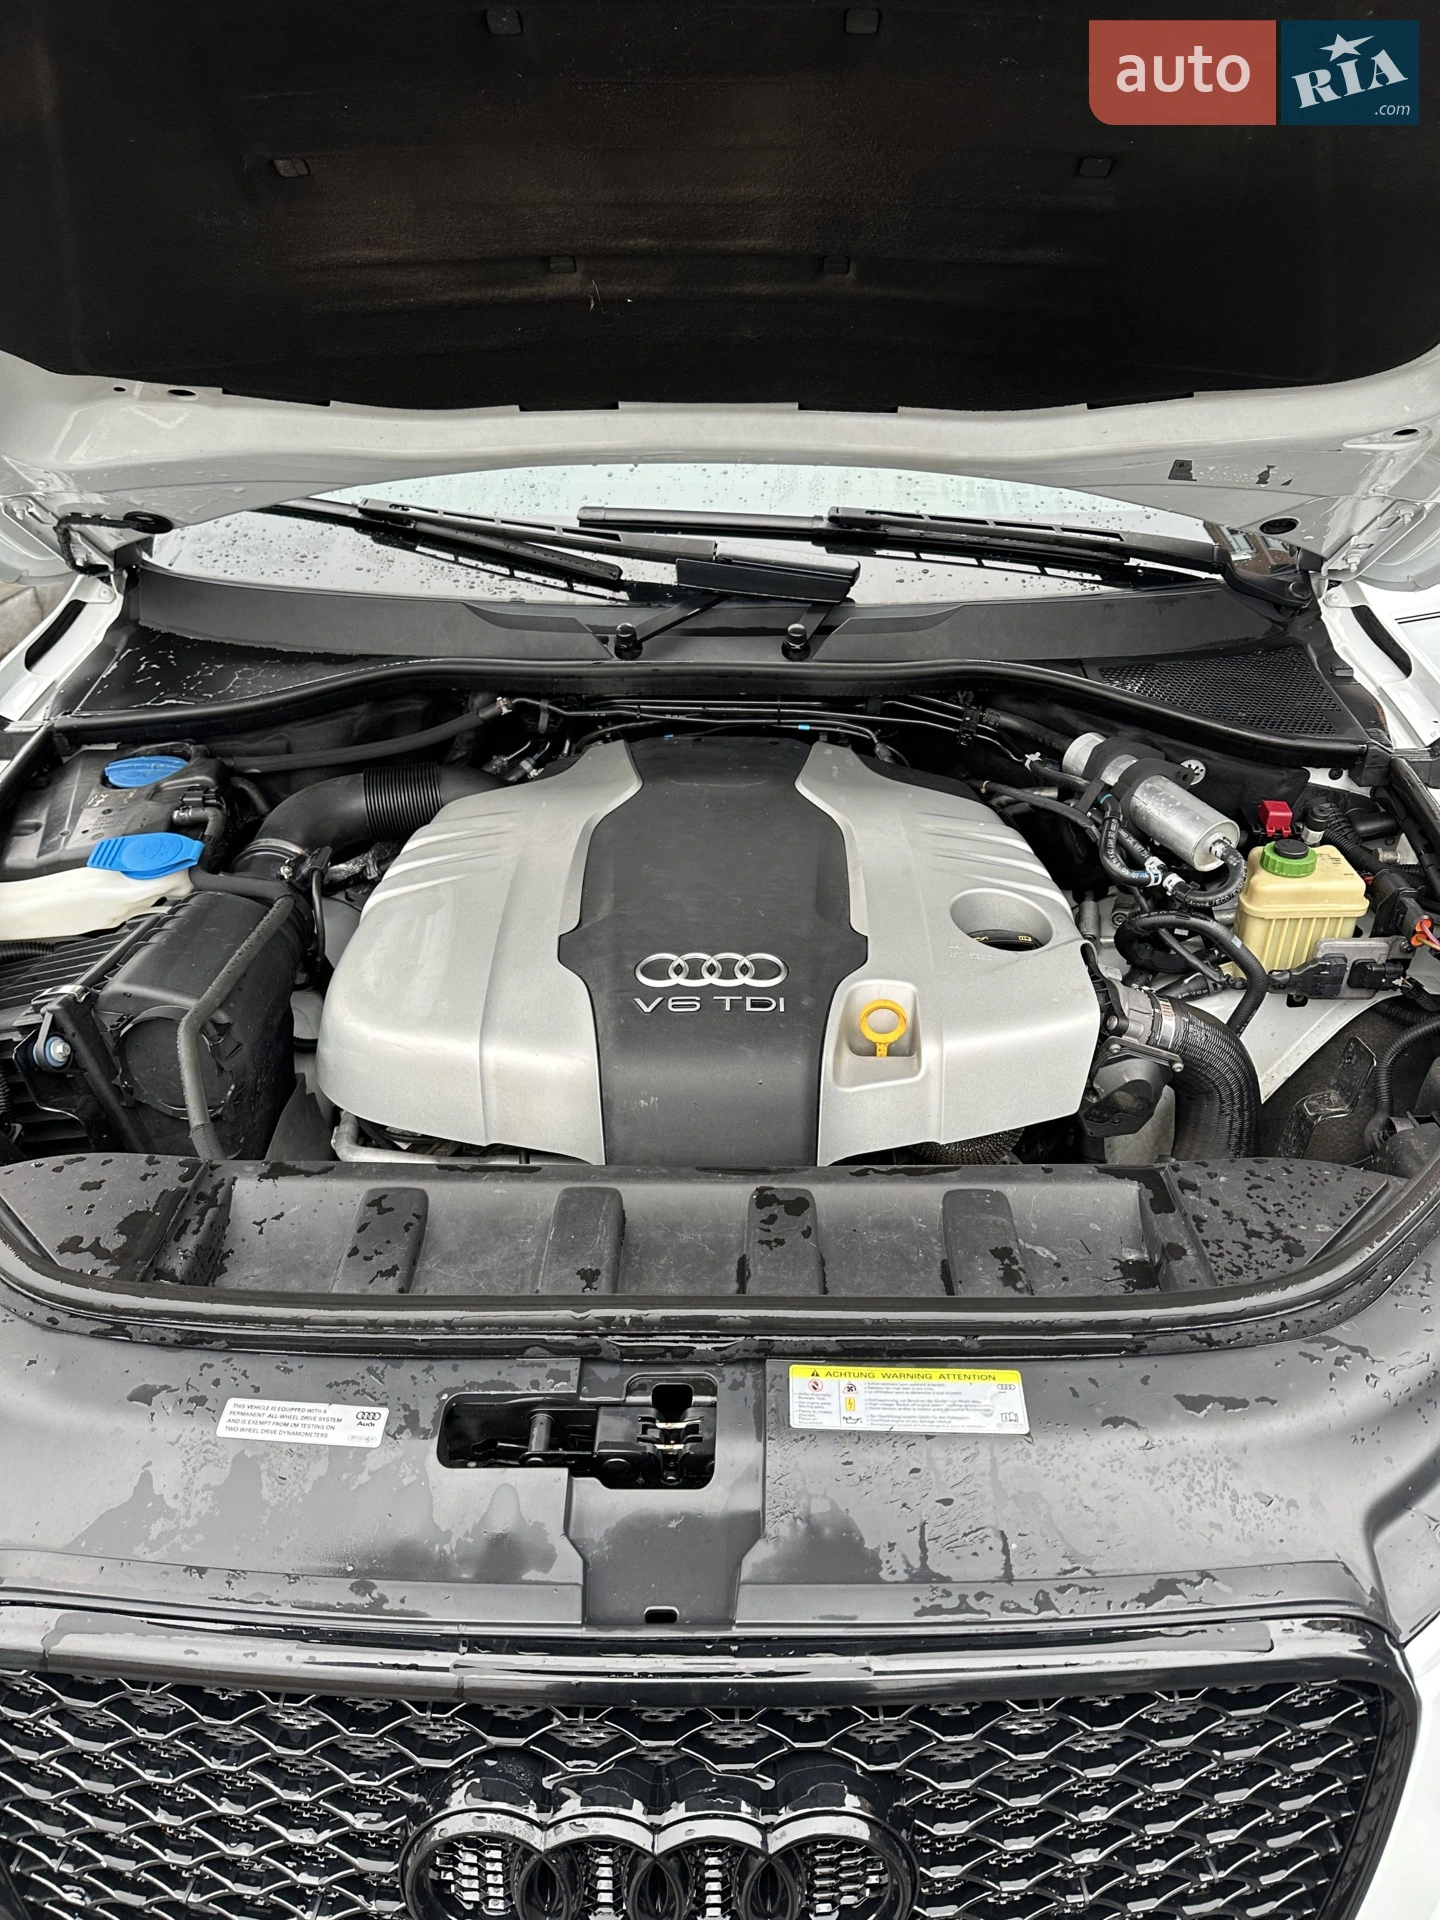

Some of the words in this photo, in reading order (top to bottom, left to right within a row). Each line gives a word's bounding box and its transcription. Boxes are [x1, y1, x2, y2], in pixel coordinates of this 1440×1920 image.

[633, 996, 701, 1013] V6
[713, 996, 785, 1012] TDI
[825, 1370, 876, 1379] ACHTUNG
[880, 1372, 933, 1380] WARNING
[938, 1373, 996, 1381] ATTENTION
[229, 1410, 265, 1418] PERMANENT
[278, 1430, 328, 1439] DYNAMOMETERS
